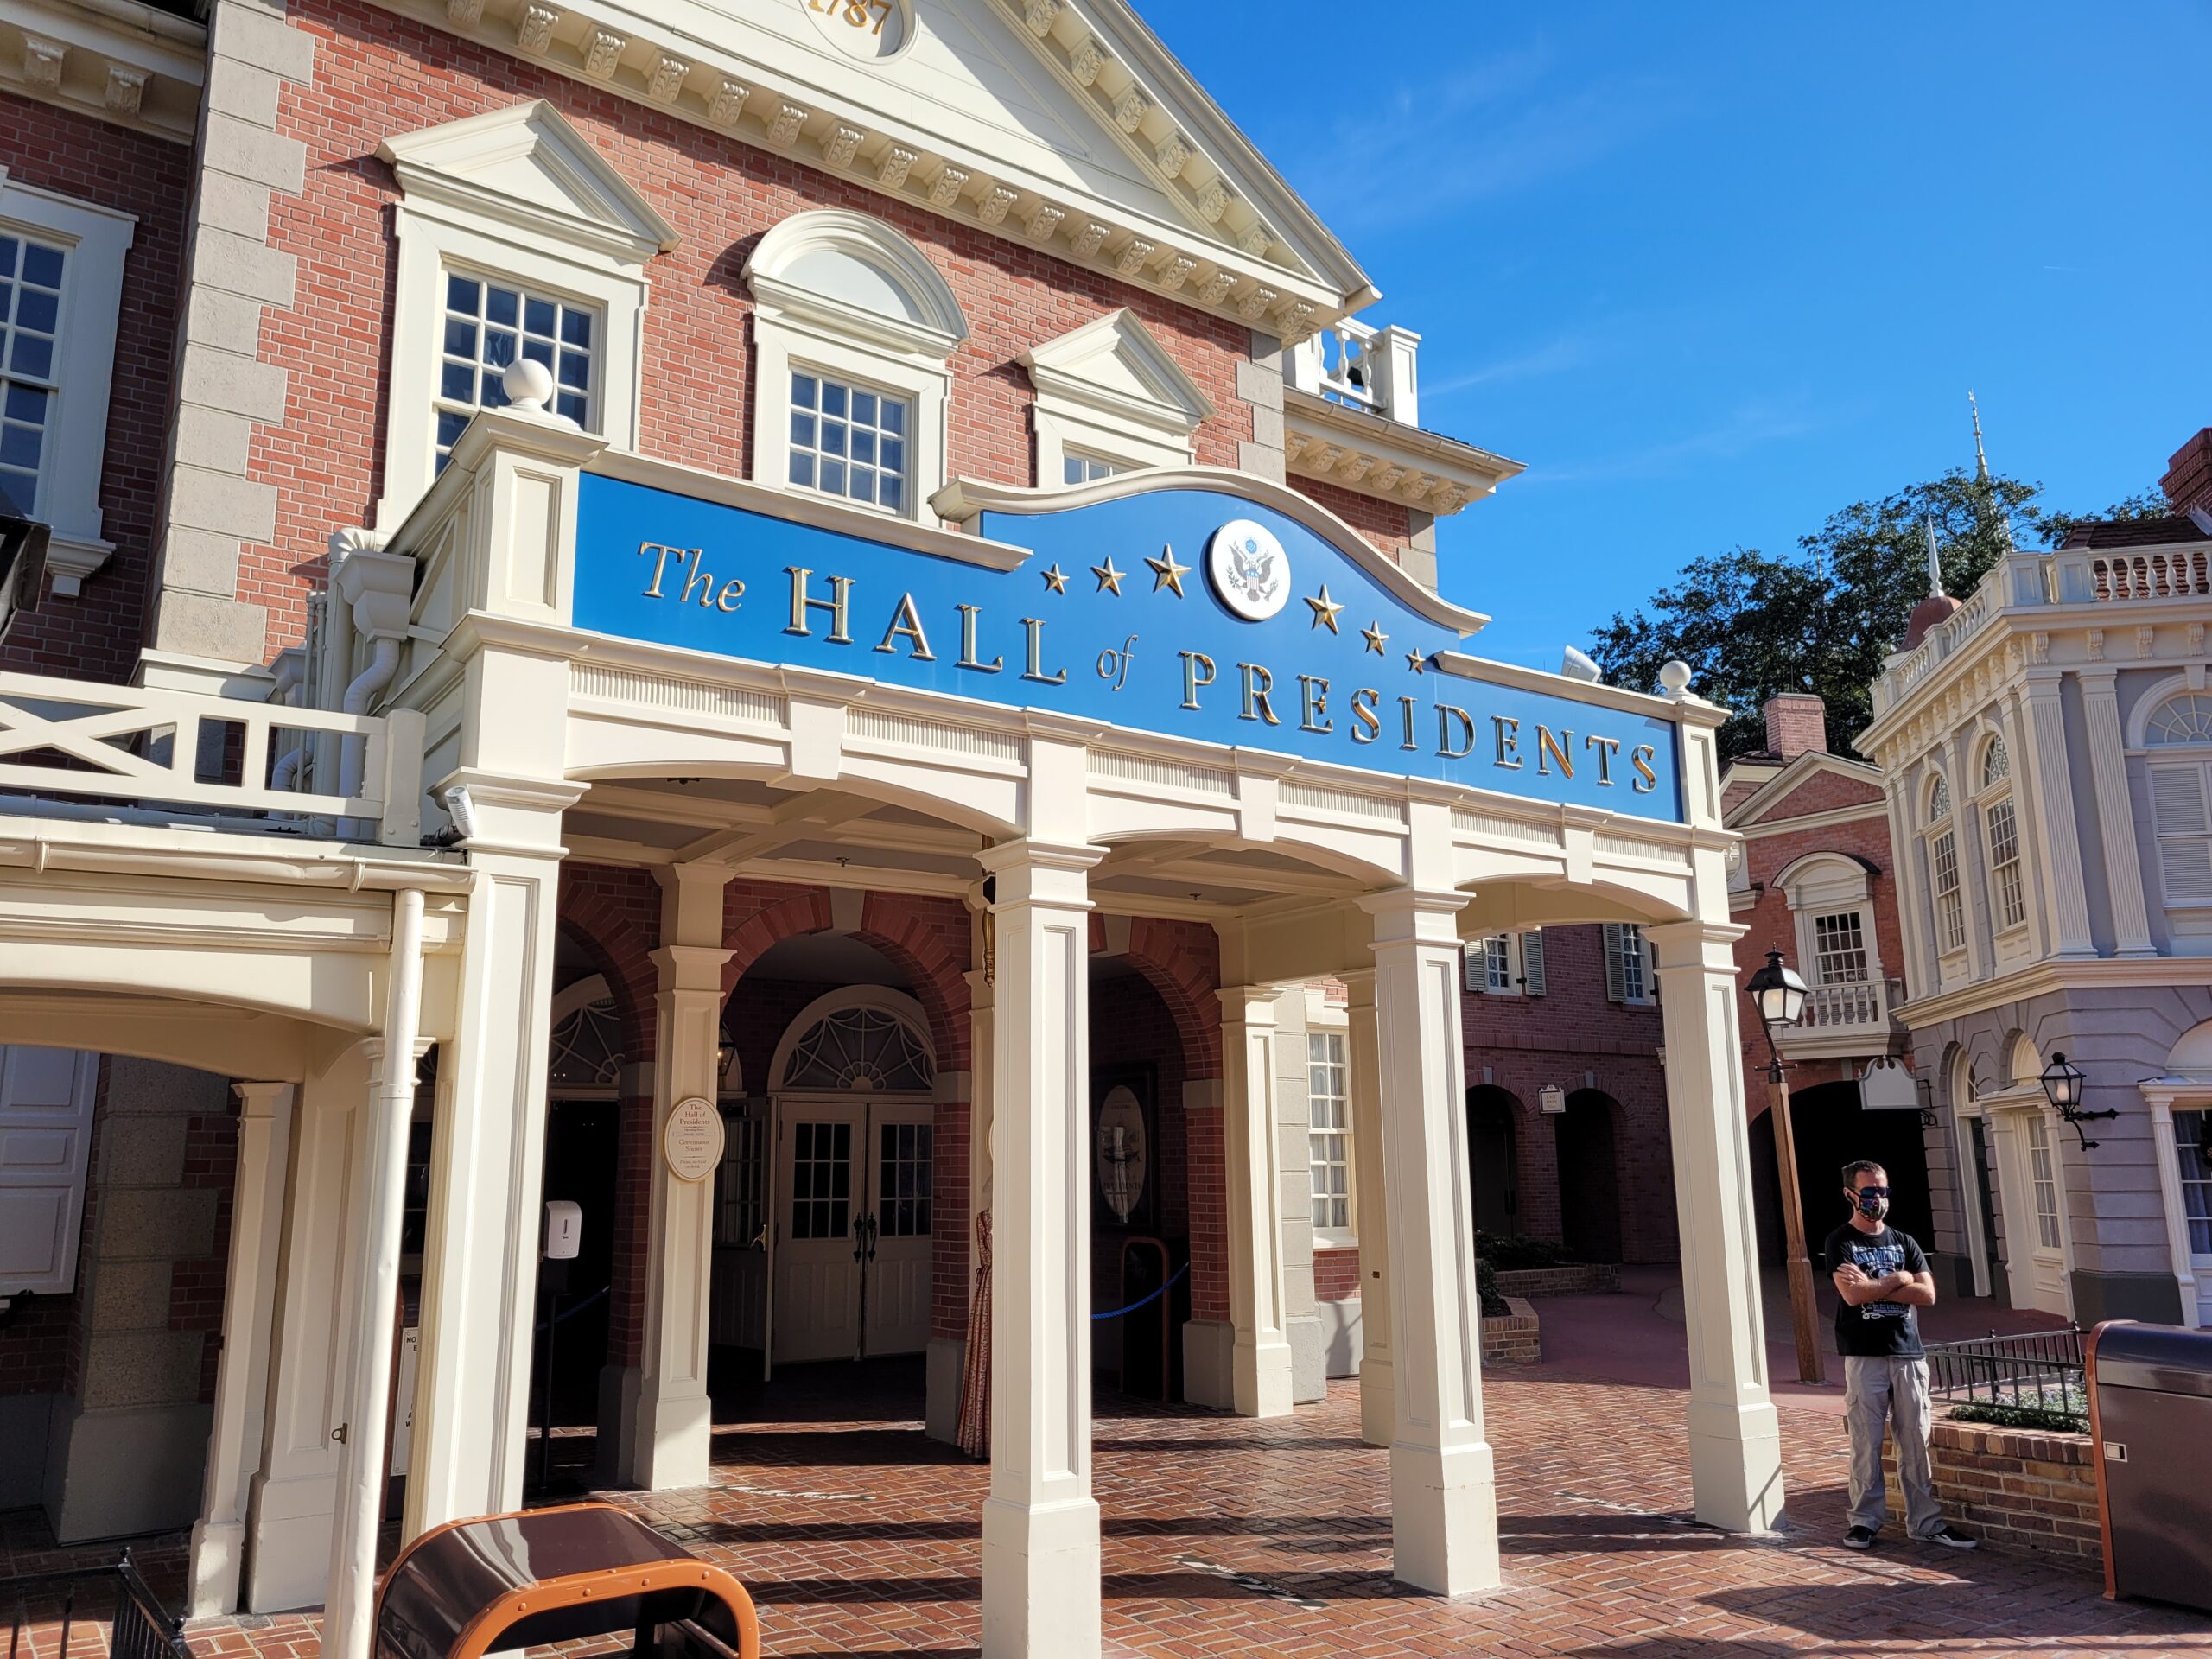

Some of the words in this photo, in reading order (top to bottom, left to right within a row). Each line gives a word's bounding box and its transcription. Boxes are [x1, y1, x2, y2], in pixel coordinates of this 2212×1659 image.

[639, 541, 746, 613] The
[781, 566, 1068, 684] HALL
[1097, 634, 1139, 691] of
[1178, 650, 1658, 793] PRESIDENTS
